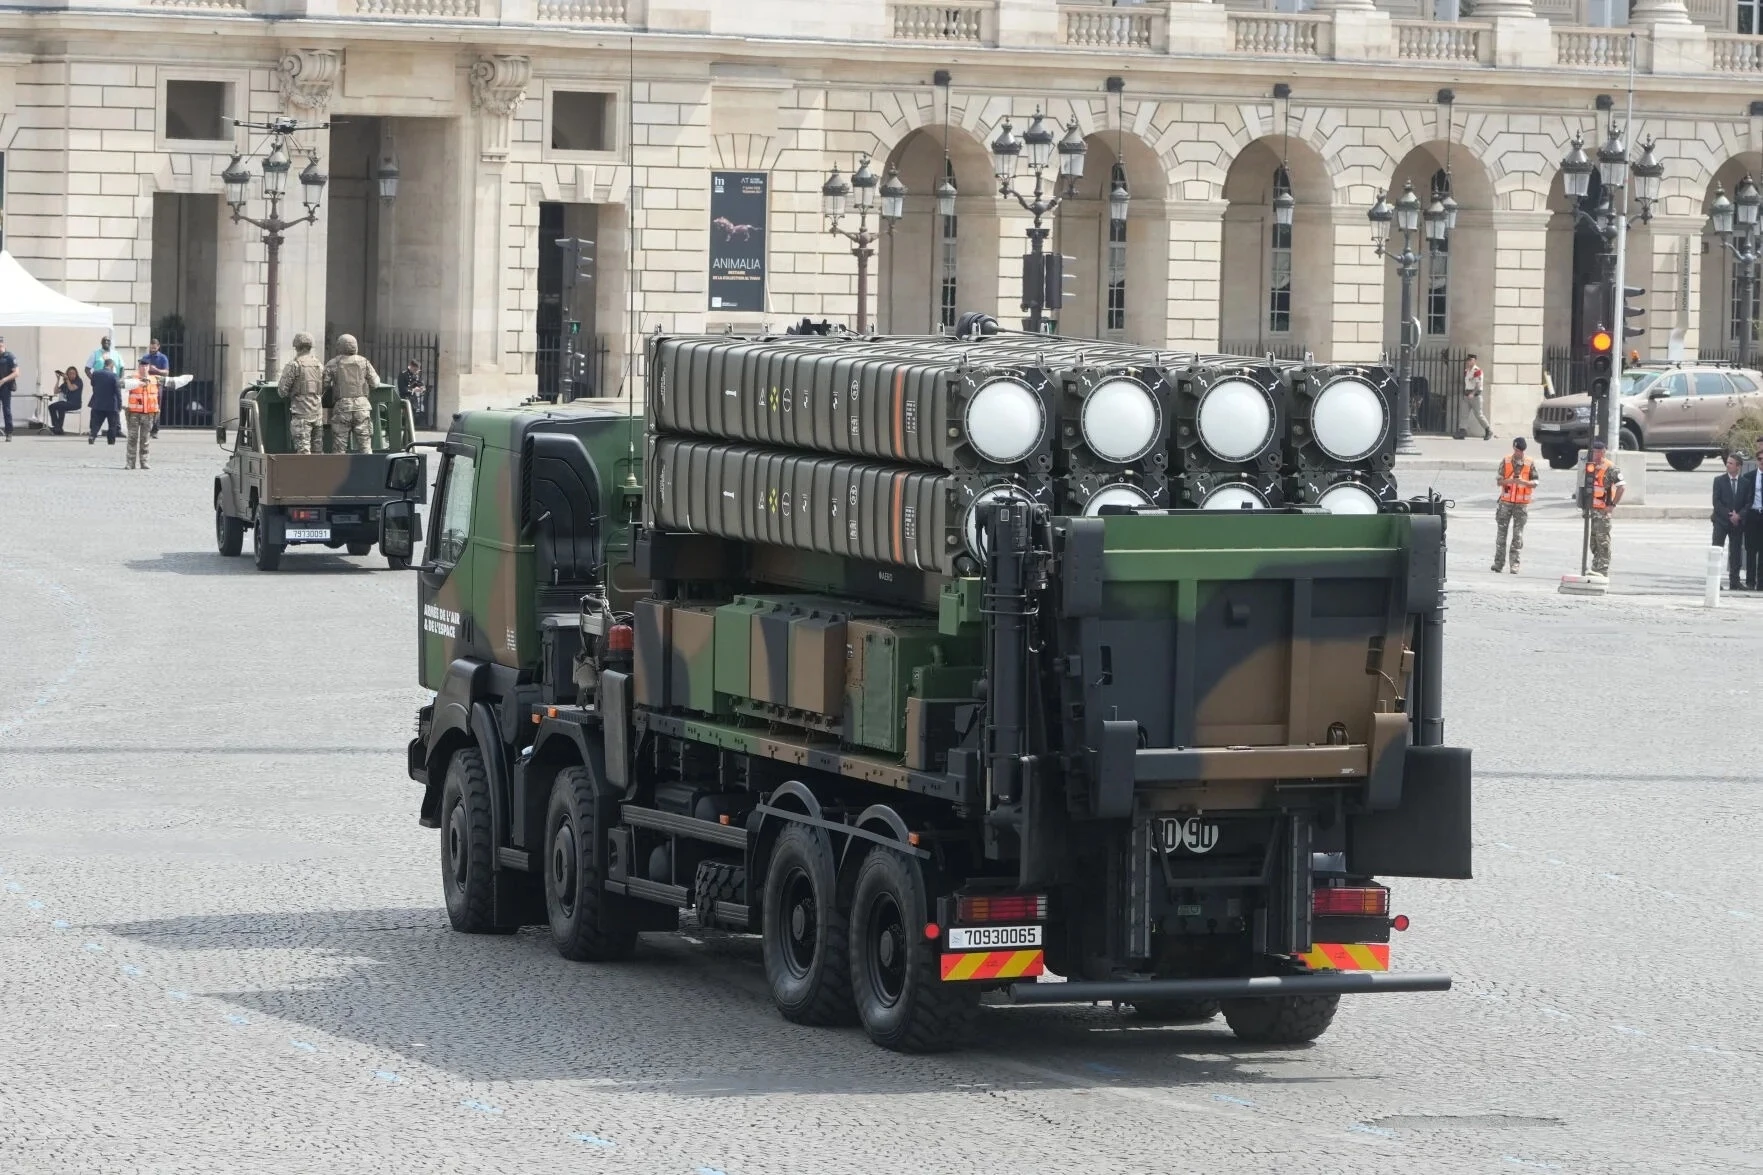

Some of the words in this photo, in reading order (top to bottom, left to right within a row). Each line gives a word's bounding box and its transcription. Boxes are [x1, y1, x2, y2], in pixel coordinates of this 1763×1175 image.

[713, 258, 761, 270] ANIMALIA
[439, 608, 446, 621] DE
[446, 611, 460, 625] L'AIR
[428, 619, 435, 633] DE
[435, 621, 456, 639] L'ESPACE
[964, 928, 1036, 945] 70930065
